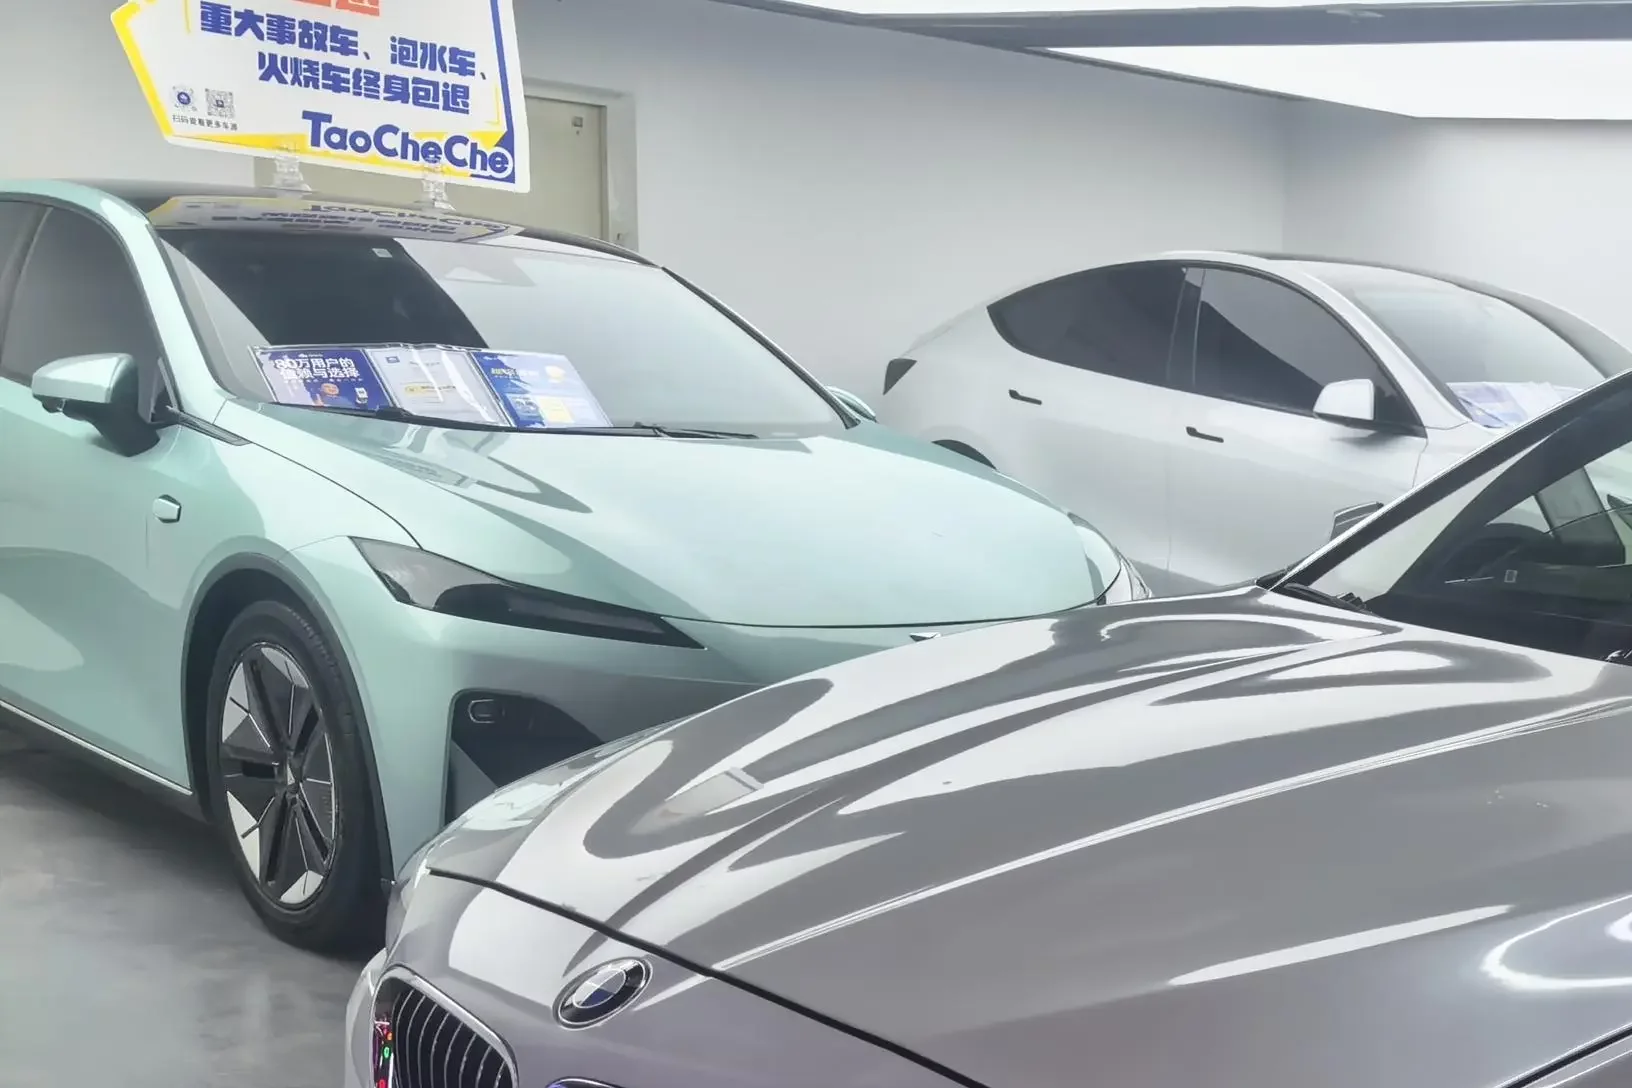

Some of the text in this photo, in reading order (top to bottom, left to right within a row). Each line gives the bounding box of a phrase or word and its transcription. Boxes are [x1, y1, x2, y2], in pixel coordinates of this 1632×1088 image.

[258, 51, 470, 115] 火烧车终身包退
[302, 110, 509, 173] TaoCheChe
